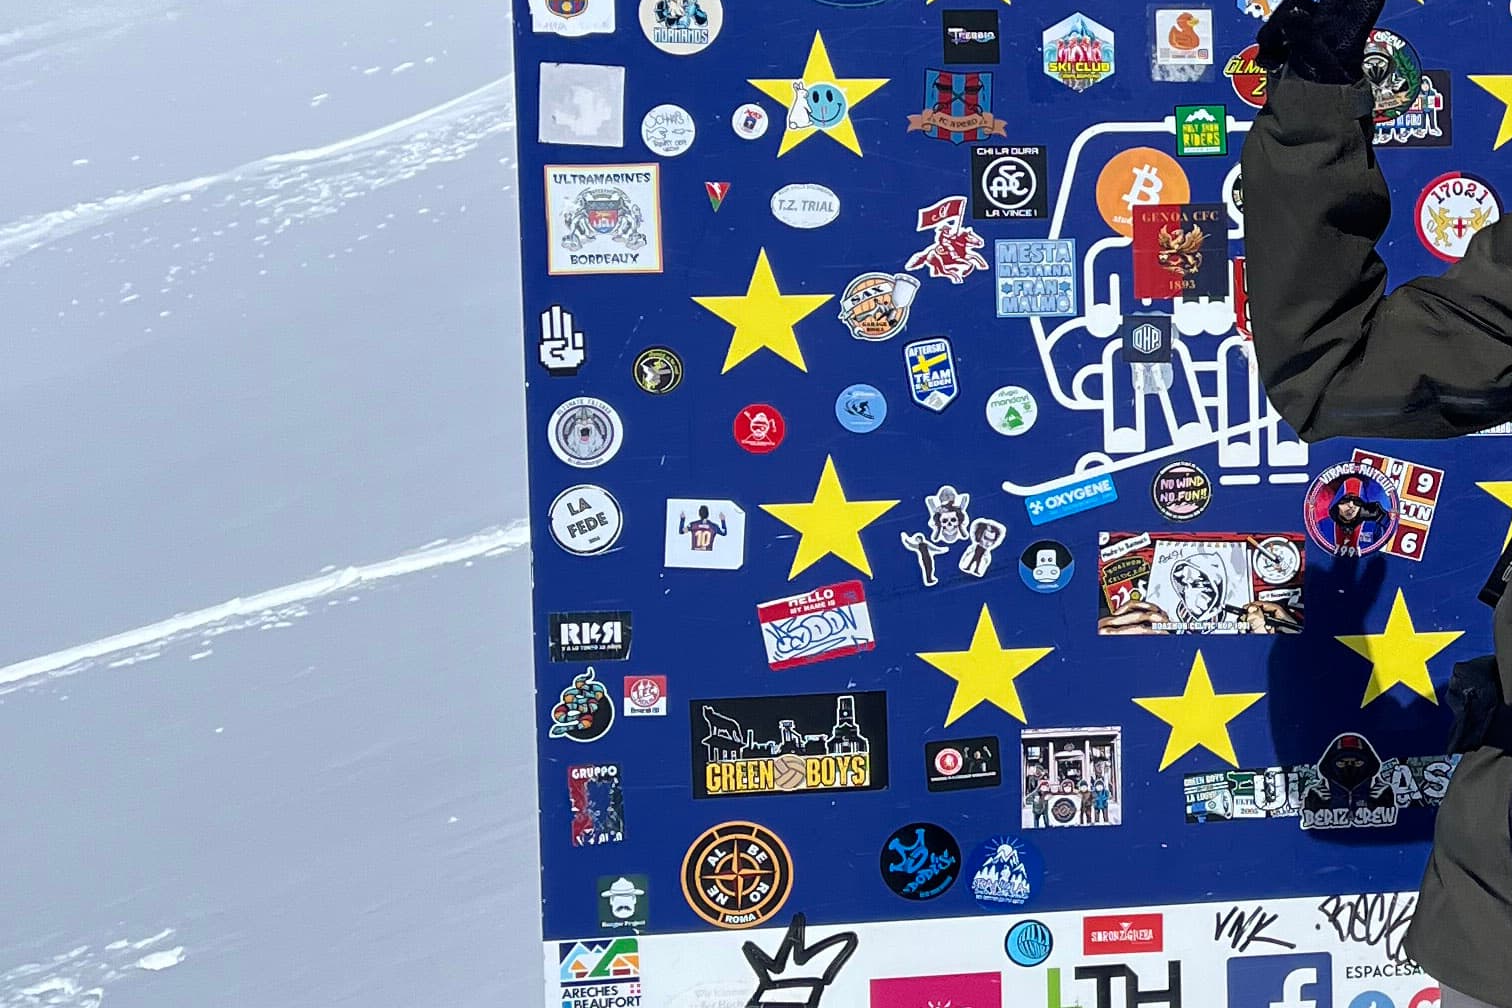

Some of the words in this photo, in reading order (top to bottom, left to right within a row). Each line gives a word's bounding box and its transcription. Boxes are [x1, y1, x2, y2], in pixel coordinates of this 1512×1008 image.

[1049, 63, 1072, 72] SKI
[1075, 63, 1110, 72] CLUB
[1183, 132, 1220, 146] RIDERS
[553, 172, 651, 185] ULTRAMARINES
[1432, 180, 1488, 205] 17021
[801, 200, 834, 212] TRIAL
[1002, 209, 1032, 217] VINCE
[1142, 212, 1188, 223] GENOA
[1193, 211, 1219, 222] CFC
[570, 253, 639, 265] BORDEAUX
[1001, 243, 1071, 263] MESTA
[851, 286, 883, 305] SAX
[913, 369, 951, 382] TEAM
[1176, 472, 1204, 489] WIND
[1044, 481, 1112, 510] OXYGENE
[566, 497, 592, 516] LA
[566, 512, 608, 539] FEDE
[695, 530, 710, 547] 10
[803, 603, 826, 612] NAME
[572, 766, 618, 780] GRUPPO
[706, 759, 775, 793] GREEN
[805, 755, 866, 787] BOYS
[1354, 806, 1396, 825] CREW
[725, 913, 756, 924] ROMA
[1346, 966, 1425, 979] ESPACESA
[562, 985, 618, 999] ARECHES
[574, 996, 641, 1008] BEAUFORT
